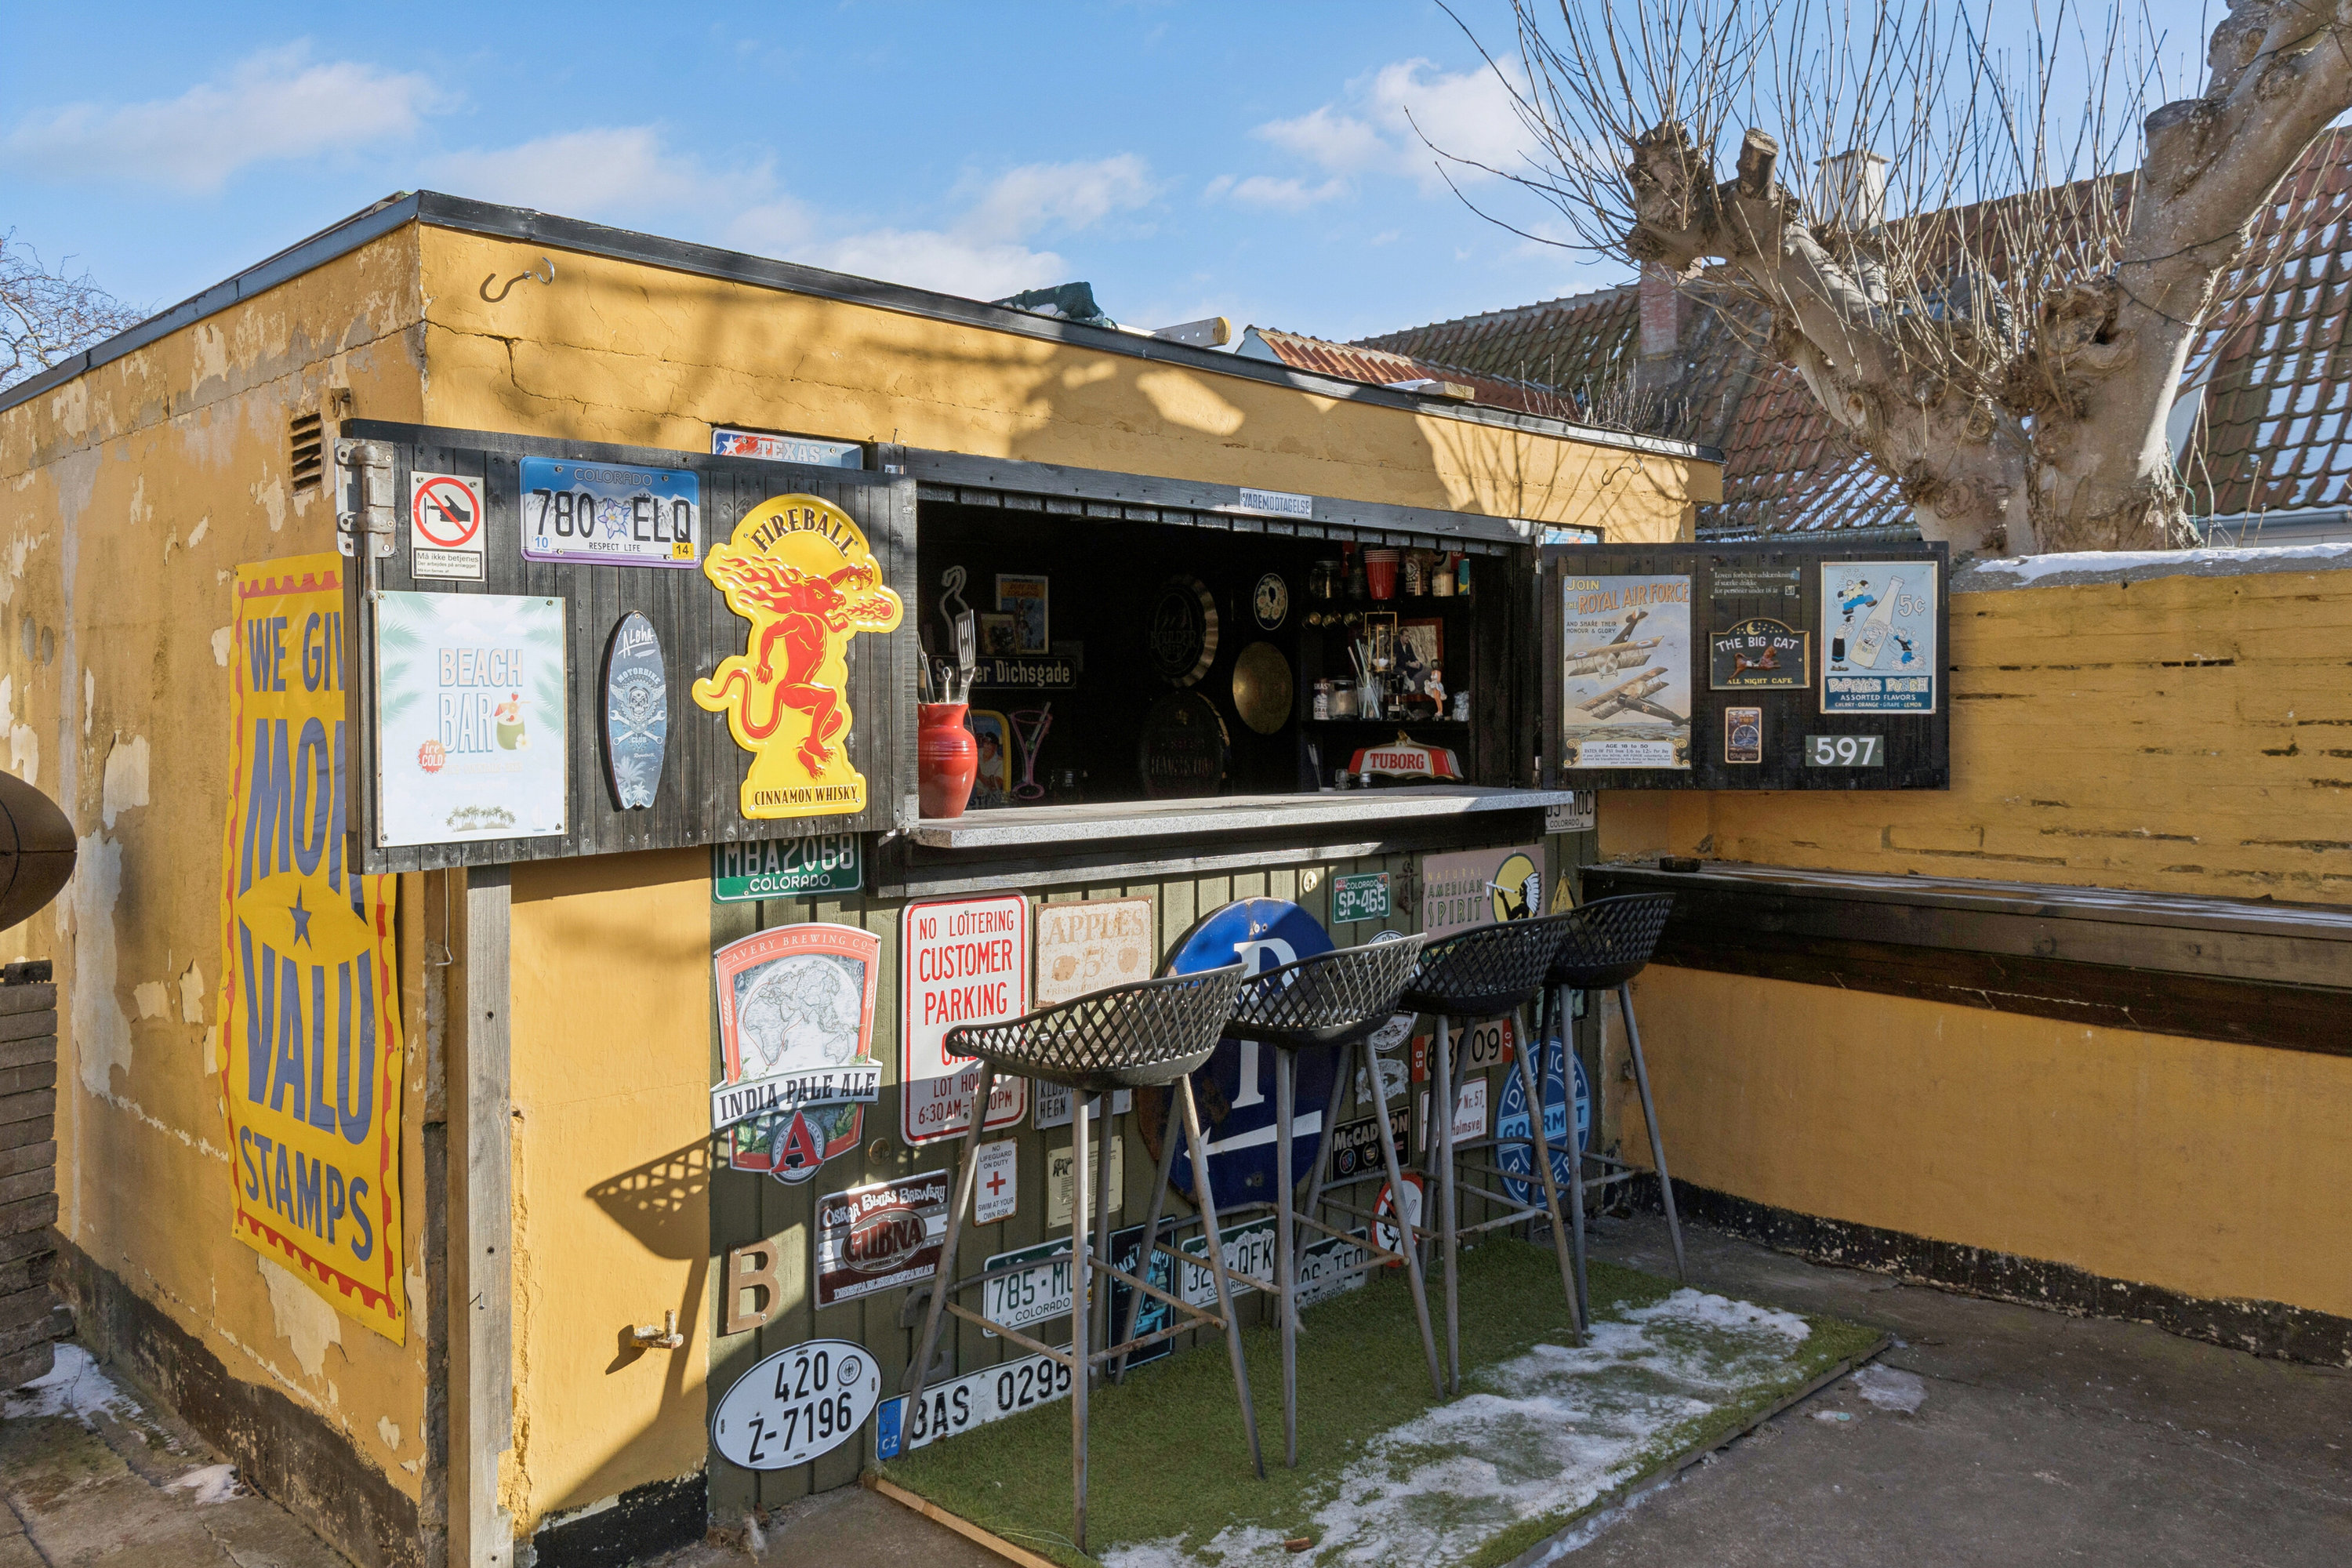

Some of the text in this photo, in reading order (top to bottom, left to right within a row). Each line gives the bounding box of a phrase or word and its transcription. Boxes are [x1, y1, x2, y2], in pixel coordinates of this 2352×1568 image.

[757, 441, 820, 463] TEXAS
[574, 468, 652, 486] COLORADO
[1242, 491, 1310, 516] VAREMODTAGELSE
[533, 489, 691, 543] 780 ELQ
[535, 536, 548, 548] 10
[751, 508, 854, 557] FIREBALL
[589, 542, 641, 552] RESPECT LIFE
[676, 545, 689, 555] 14
[448, 554, 479, 563] betjenes
[1566, 579, 1599, 591] JOIN
[1733, 572, 1756, 580] forbyder
[1757, 572, 1795, 580] udskænkning
[1566, 583, 1690, 615] THE ROYAL AIR FORCE
[1898, 594, 1926, 617] 5¢
[248, 615, 288, 692] WE
[1715, 637, 1799, 652] THE BIG CAT
[439, 648, 523, 687] BEACH
[617, 667, 660, 684] MOTORBIKE
[995, 659, 1070, 687] Dichsgade
[1886, 677, 1929, 693] PUNCH
[439, 693, 493, 753] BAR
[425, 742, 440, 753] ice
[1815, 737, 1876, 765] 597
[422, 754, 443, 767] COLD
[1370, 752, 1425, 771] TUBORG
[754, 785, 858, 806] CINNAMON WHISKY
[1549, 818, 1580, 828] COLORADO
[724, 833, 855, 878] MBA2068
[750, 873, 830, 892] COLORADO
[1428, 866, 1482, 881] NATURAL
[1346, 880, 1377, 890] COLORADO
[1428, 879, 1483, 898] AMERICAN
[1428, 896, 1483, 927] SPIRIT
[920, 909, 1014, 940] NO LOITERING
[1046, 909, 1145, 946] APPLES
[732, 934, 846, 963] AVERY BREWING
[920, 938, 1013, 982] CUSTOMER
[925, 982, 1007, 1025] PARKING
[238, 914, 371, 1145] VALU
[719, 1073, 877, 1121] INDIA PALE ALE
[934, 1077, 953, 1098] LOT
[1040, 1097, 1066, 1119] HEGN
[808, 1123, 822, 1155] BREWING
[1334, 1114, 1408, 1152] McCADON
[980, 1150, 1012, 1162] LIFEGUARD
[993, 1159, 1009, 1167] DUTY
[240, 1125, 370, 1262] STAMPS
[978, 1202, 992, 1212] SWIM
[1000, 1196, 1014, 1206] YOUR
[983, 1208, 1009, 1220] OWN RISK
[844, 1218, 924, 1262] GUBNA
[862, 1258, 893, 1269] IMPERIAL
[727, 1237, 781, 1334] B
[1306, 1284, 1345, 1305] COLORADO
[1015, 1298, 1070, 1321] COLORADO
[775, 1350, 829, 1403] 420
[997, 1352, 1072, 1411] 0295
[749, 1392, 851, 1463] Z-7196
[882, 1432, 898, 1451] CZ
